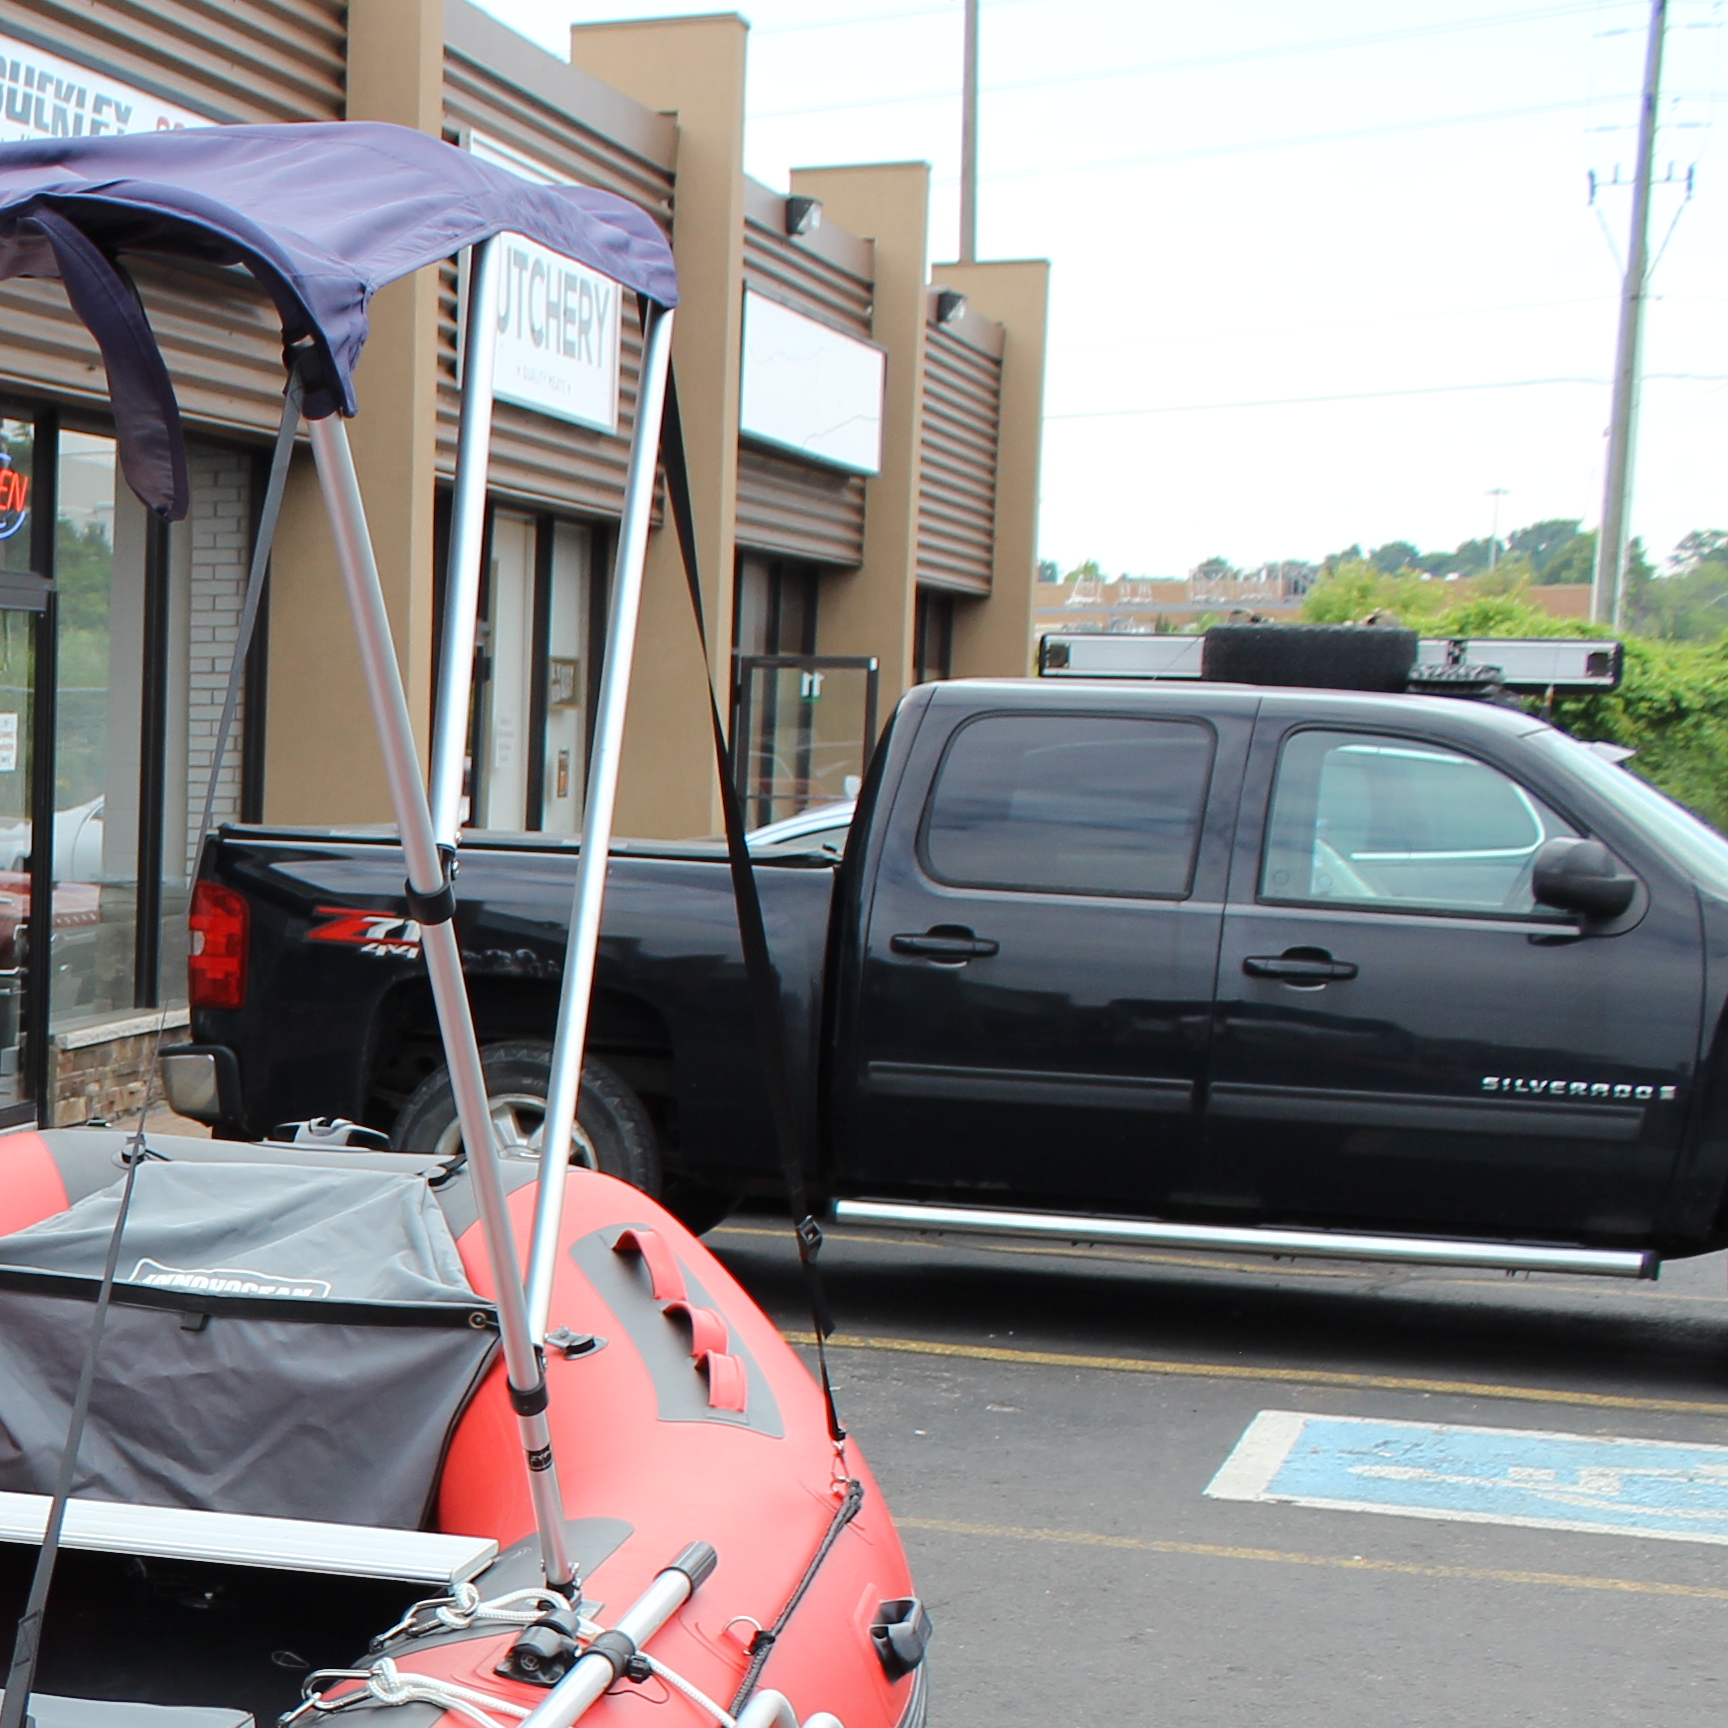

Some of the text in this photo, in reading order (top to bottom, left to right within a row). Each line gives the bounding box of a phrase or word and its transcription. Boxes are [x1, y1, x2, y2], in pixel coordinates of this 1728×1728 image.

[496, 246, 610, 368] UTCHERY
[306, 905, 421, 945] Z71
[1482, 1076, 1654, 1100] SILVERADO
